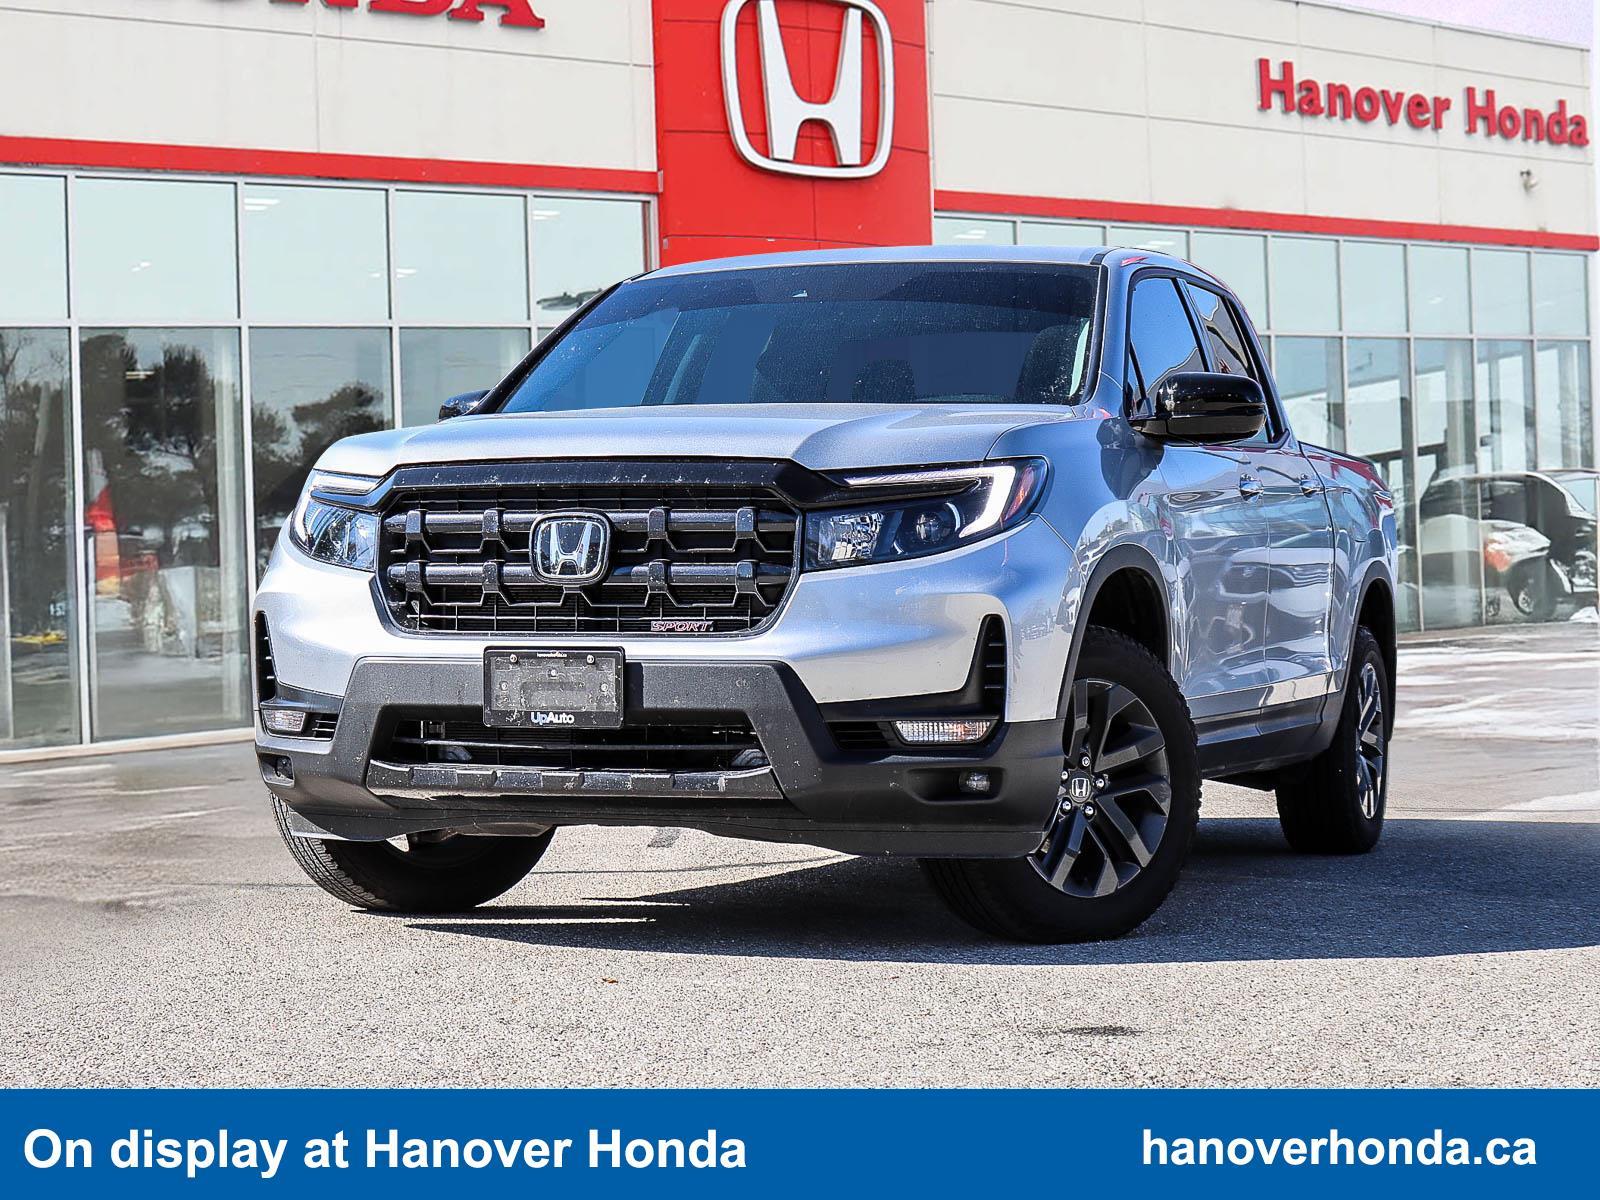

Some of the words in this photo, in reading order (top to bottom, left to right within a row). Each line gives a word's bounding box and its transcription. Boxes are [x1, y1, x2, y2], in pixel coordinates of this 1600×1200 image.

[1257, 57, 1452, 131] Hanover
[1465, 85, 1591, 146] Honda
[651, 620, 714, 632] SPORT
[530, 711, 575, 725] UpAuto
